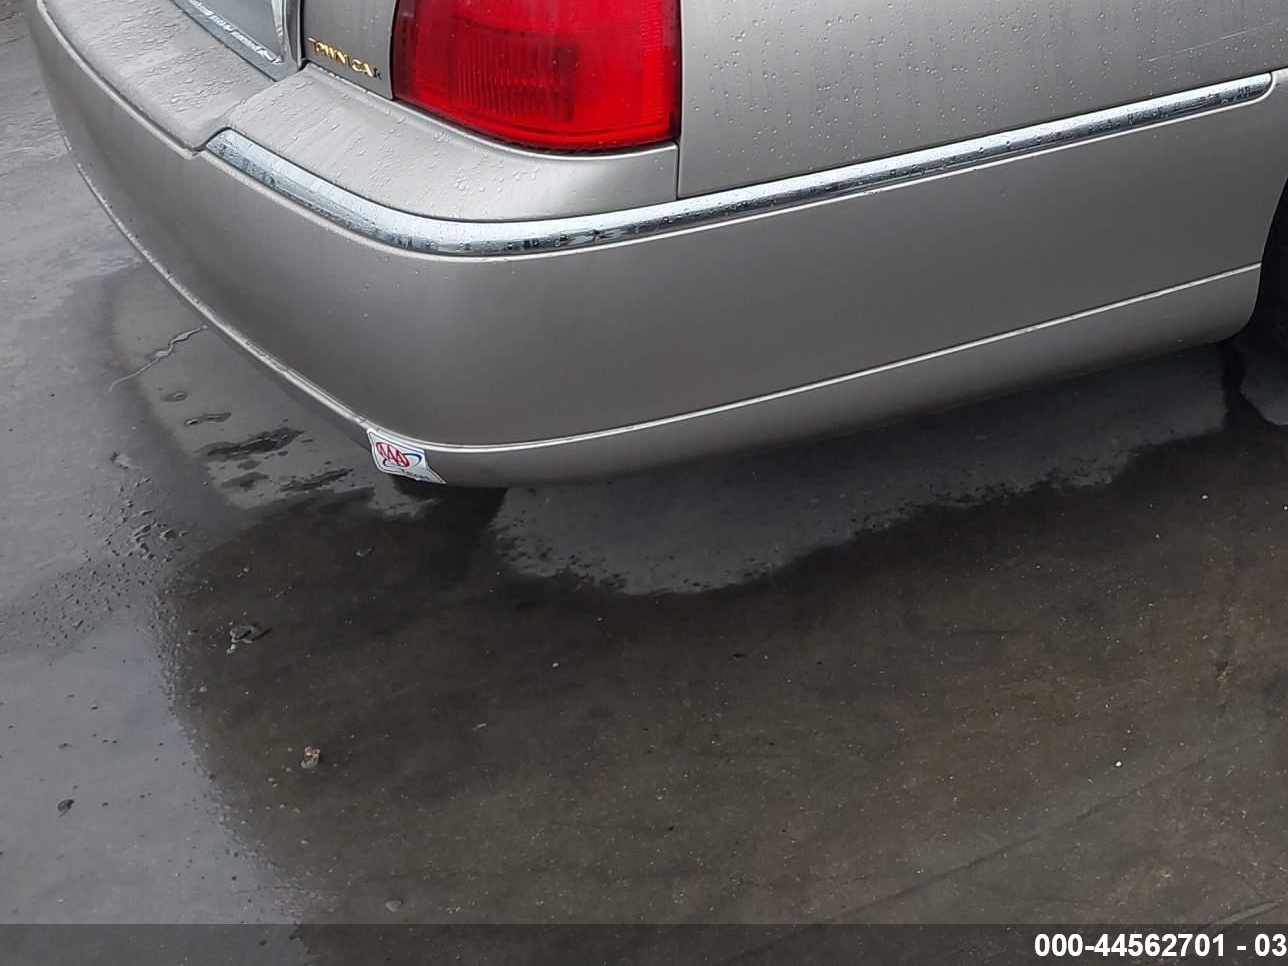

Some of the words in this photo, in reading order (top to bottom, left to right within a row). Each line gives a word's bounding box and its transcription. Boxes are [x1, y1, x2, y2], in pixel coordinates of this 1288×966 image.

[307, 37, 350, 67] TOWN
[351, 57, 382, 81] CAR
[376, 442, 410, 467] AAA
